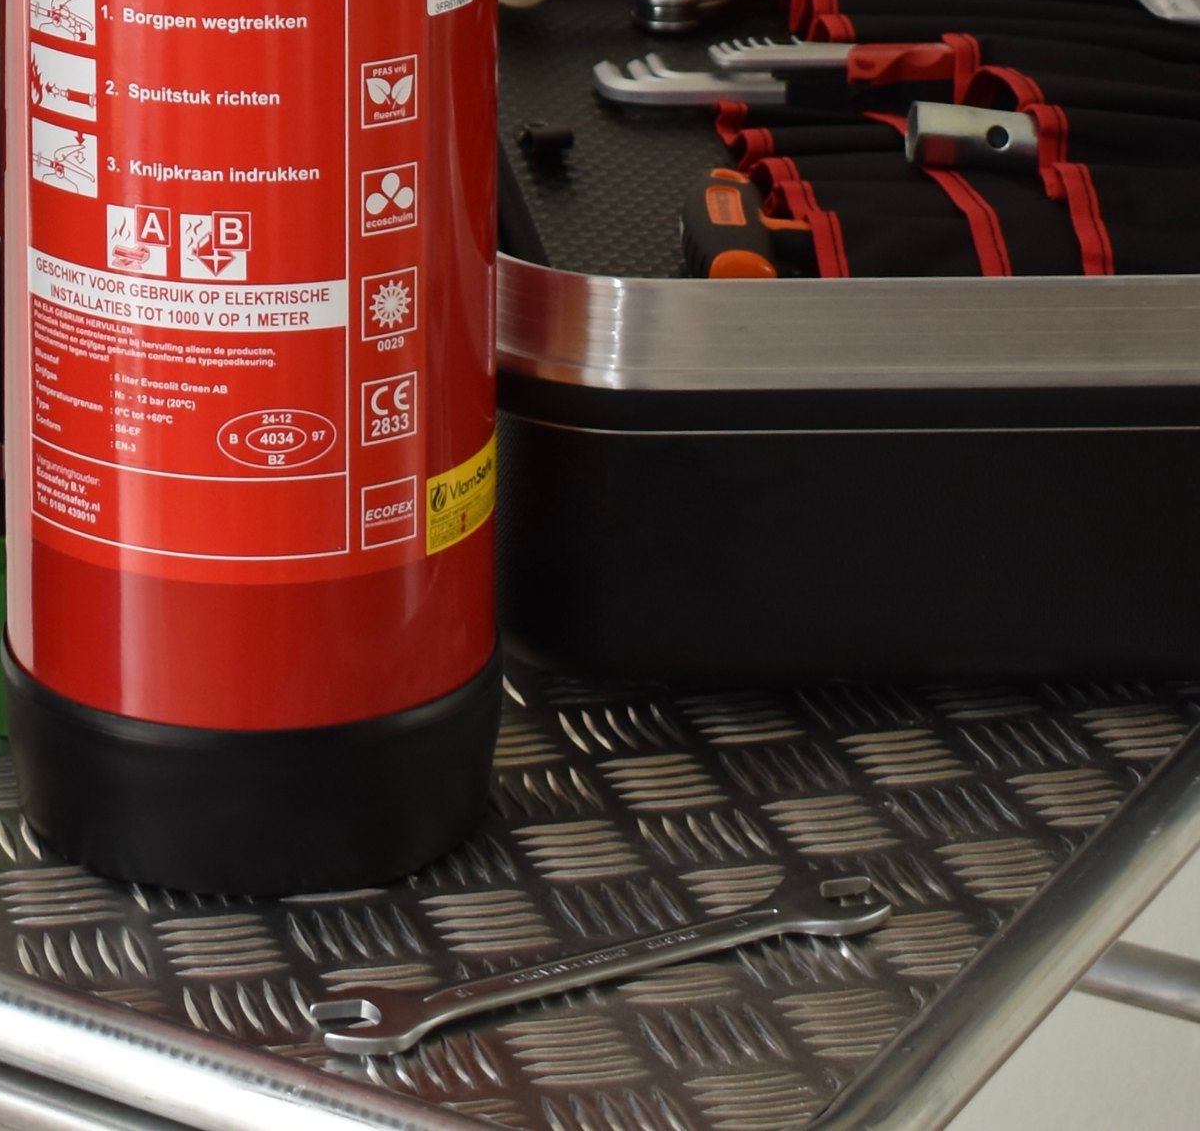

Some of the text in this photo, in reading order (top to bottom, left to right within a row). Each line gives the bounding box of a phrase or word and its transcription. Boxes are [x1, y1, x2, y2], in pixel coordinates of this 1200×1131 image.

[100, 3, 308, 33] 1. Borgpen wegtrekken
[372, 63, 407, 77] PFAS vrij
[104, 80, 280, 106] 2. Spuitstuk richten
[373, 106, 406, 120] fluorvrij
[106, 156, 320, 184] 3. Knijpkraan indrukken
[140, 212, 165, 241] A
[219, 217, 244, 245] B
[365, 212, 414, 229] ecoschuim
[36, 257, 330, 305] GESCHIKT VOOR GEBRUIK OP ELEKTRISCHE
[50, 283, 310, 327] INSTALLATIES TOT 1000 V OP 1 METER
[55, 307, 85, 324] GEBRUIK
[86, 316, 135, 335] HERVULLEN.
[76, 327, 117, 343] controleren
[118, 336, 127, 345] en
[129, 336, 140, 348] bij
[141, 339, 183, 354] hervulling
[185, 346, 211, 355] alleen
[214, 346, 225, 355] de
[377, 336, 405, 352] 0029
[107, 345, 146, 358] gebruiken
[148, 352, 183, 363] conform
[185, 355, 196, 364] de
[114, 373, 121, 382] 6
[121, 373, 139, 386] liter
[140, 377, 179, 391] Evocolit
[180, 383, 210, 394] Green
[212, 384, 228, 394] AB
[35, 381, 104, 412] Temperatuurgrenzen
[35, 397, 50, 410] Type
[137, 394, 147, 404] 12
[149, 395, 164, 406] bar
[371, 380, 410, 415] CE
[131, 410, 144, 421] tot
[261, 413, 293, 424] 24-12
[371, 413, 410, 437] 2833
[115, 440, 137, 452] EN-3
[229, 430, 326, 444] B 4034 97
[268, 454, 286, 465] BZ
[36, 466, 69, 490] Ecosafety
[36, 481, 100, 512] www.ecosafety.nl
[365, 499, 414, 522] ECOFEX
